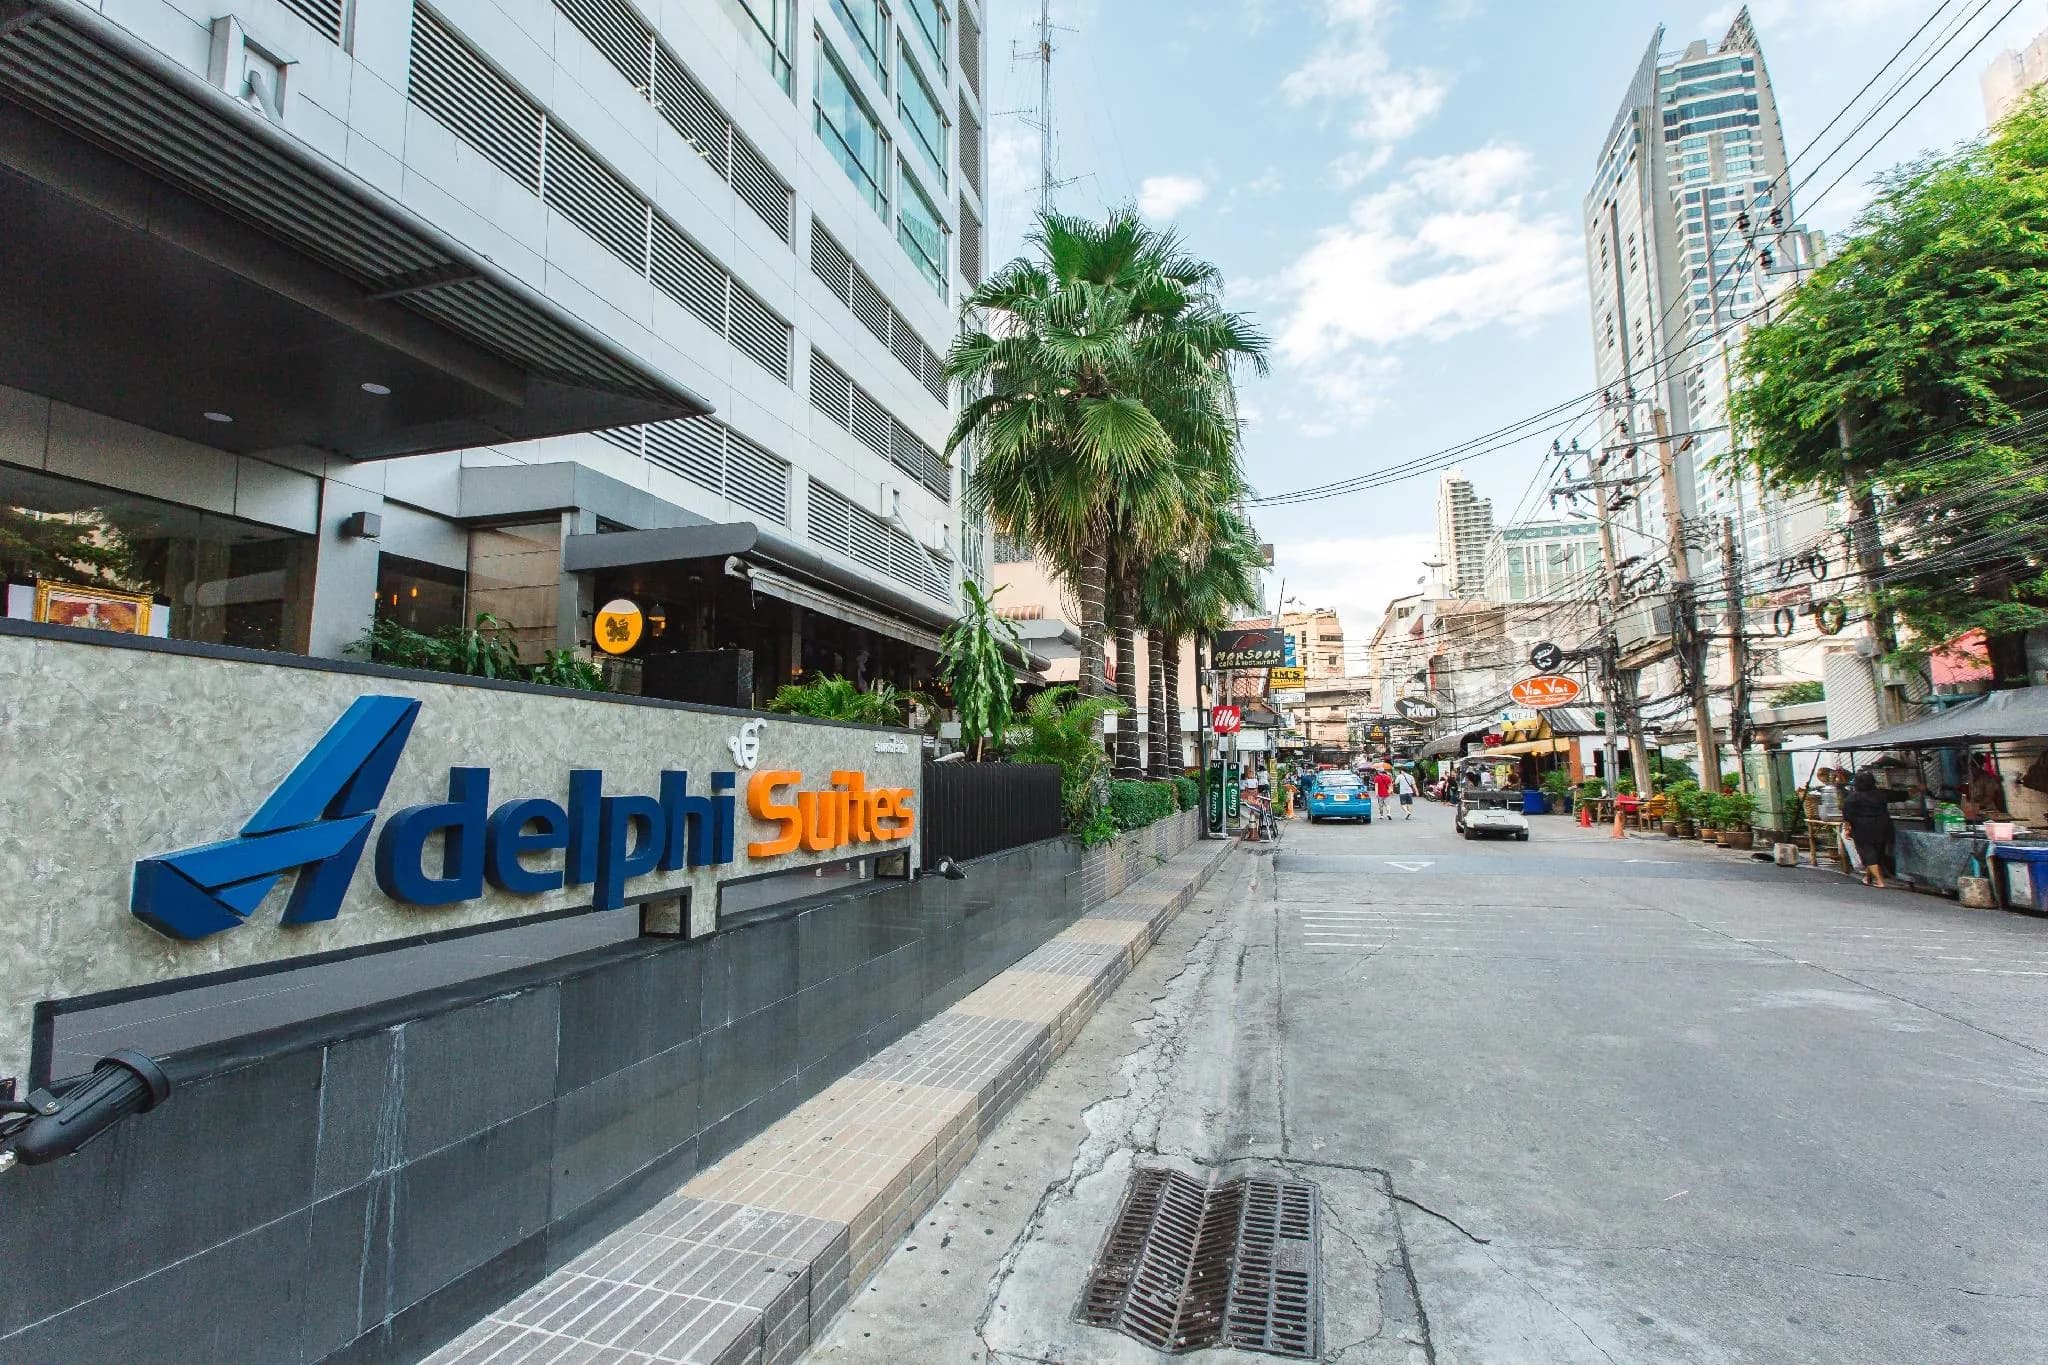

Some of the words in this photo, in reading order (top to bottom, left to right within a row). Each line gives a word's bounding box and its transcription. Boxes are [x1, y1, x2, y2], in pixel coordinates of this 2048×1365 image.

[1519, 680, 1543, 695] Via
[1544, 678, 1568, 693] Vai
[1215, 709, 1240, 731] illy
[1228, 788, 1239, 817] Chang
[131, 694, 736, 941] Adelphi
[747, 769, 914, 857] Suites
